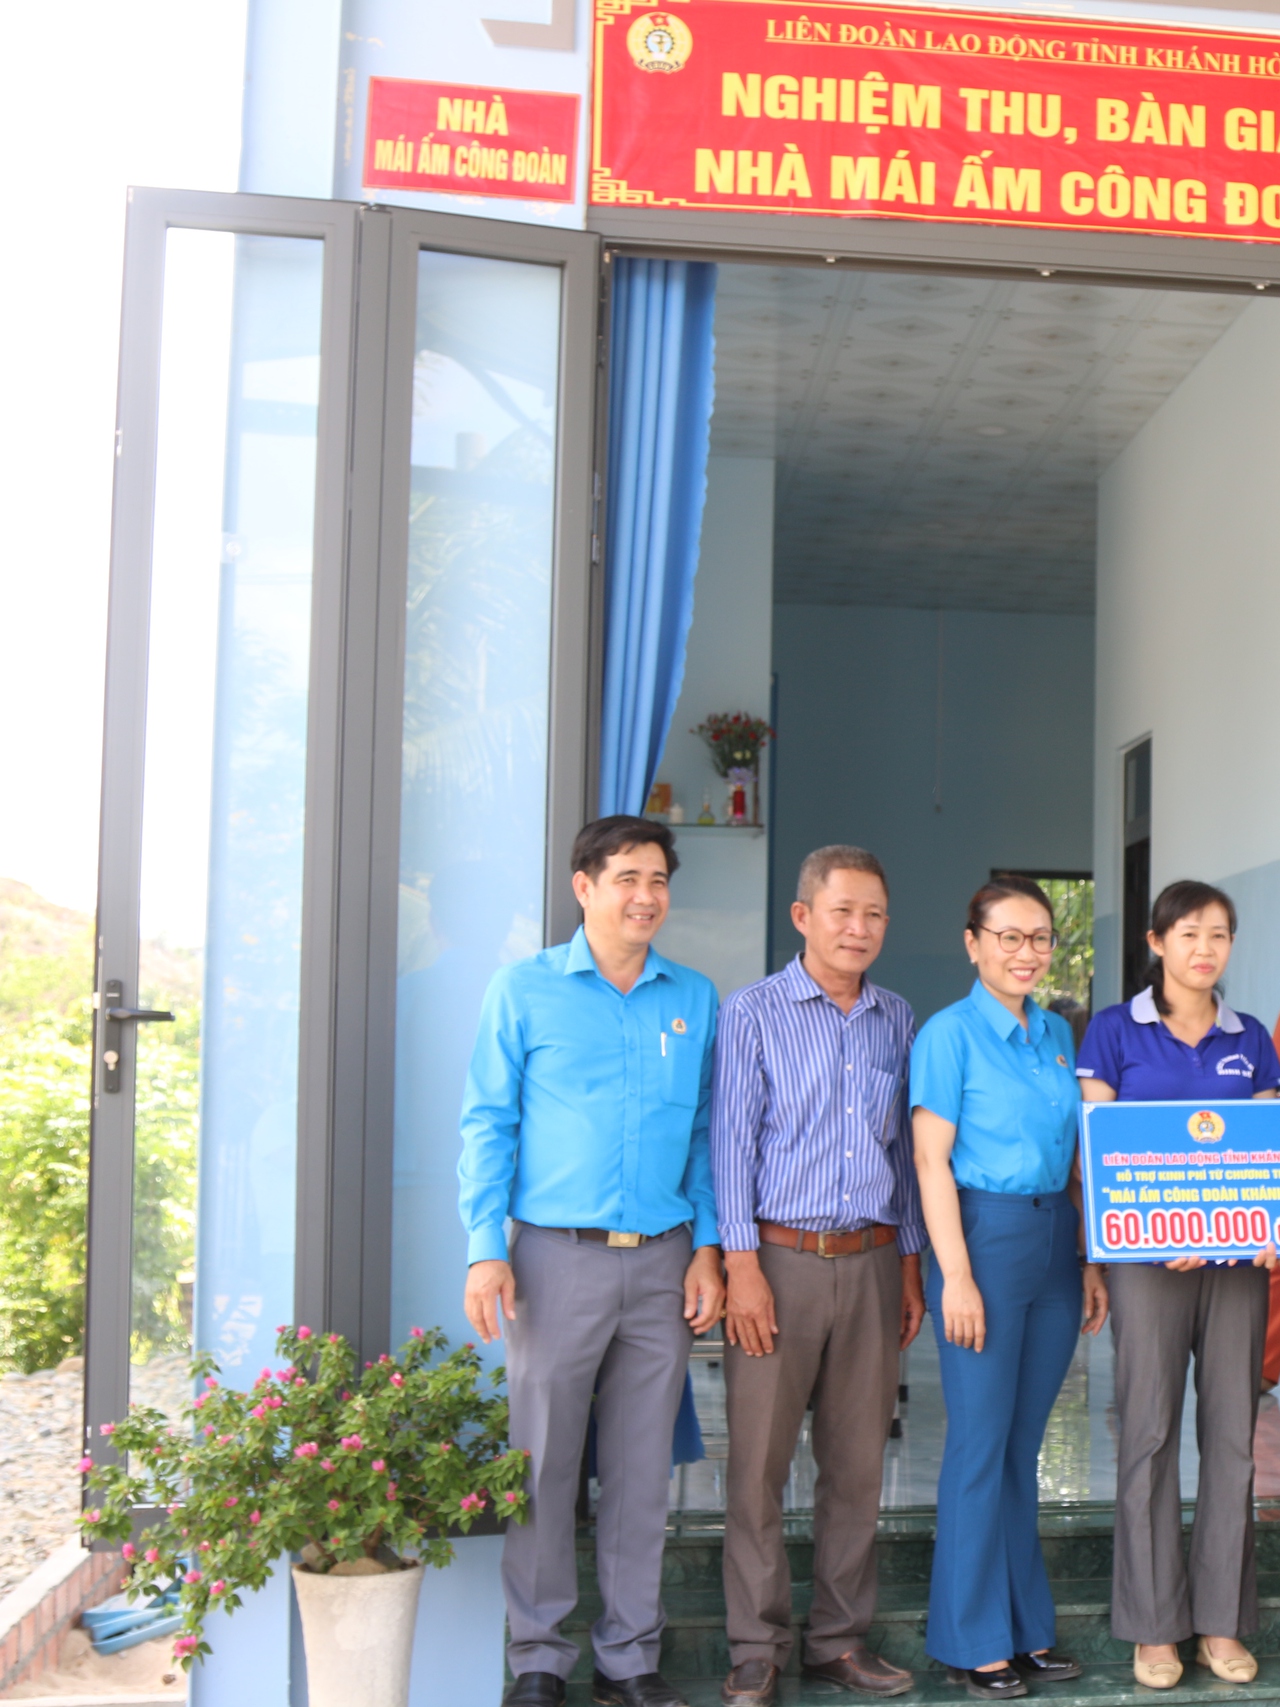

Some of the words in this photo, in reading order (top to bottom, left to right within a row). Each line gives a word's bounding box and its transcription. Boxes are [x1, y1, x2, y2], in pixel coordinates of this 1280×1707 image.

[766, 16, 831, 43] LIÊN
[839, 18, 916, 49] ĐOÀN
[923, 31, 982, 54] LAO
[987, 33, 1066, 62] ĐỘNG
[1072, 36, 1137, 65] TỈNH
[1146, 45, 1242, 74] KHÁNH
[436, 95, 509, 137] NHÀ
[721, 72, 942, 135] NGHIỆM
[959, 87, 1078, 145] THU,
[1096, 91, 1206, 149] BÀN
[373, 134, 414, 174] MÁI
[416, 132, 451, 176] ẤM
[454, 140, 509, 181] CÔNG
[512, 146, 568, 186] ĐOÀN
[694, 142, 813, 199] NHÀ
[830, 150, 936, 206] MÁI
[953, 148, 1041, 213] ẤM
[1060, 163, 1207, 225] CÔNG
[1103, 1152, 1130, 1166] LIÊN
[1131, 1151, 1164, 1165] ĐOÀN
[1165, 1153, 1187, 1164] LAO
[1188, 1150, 1221, 1167] ĐỘNG
[1222, 1149, 1249, 1163] TỈNH
[1158, 1171, 1185, 1181] KINH
[1187, 1170, 1207, 1180] PHÍ
[1138, 1185, 1161, 1202] ẤM
[1163, 1186, 1200, 1202] CÔNG
[1201, 1186, 1239, 1201] ĐOÀN
[1104, 1208, 1268, 1247] 60.000.000
